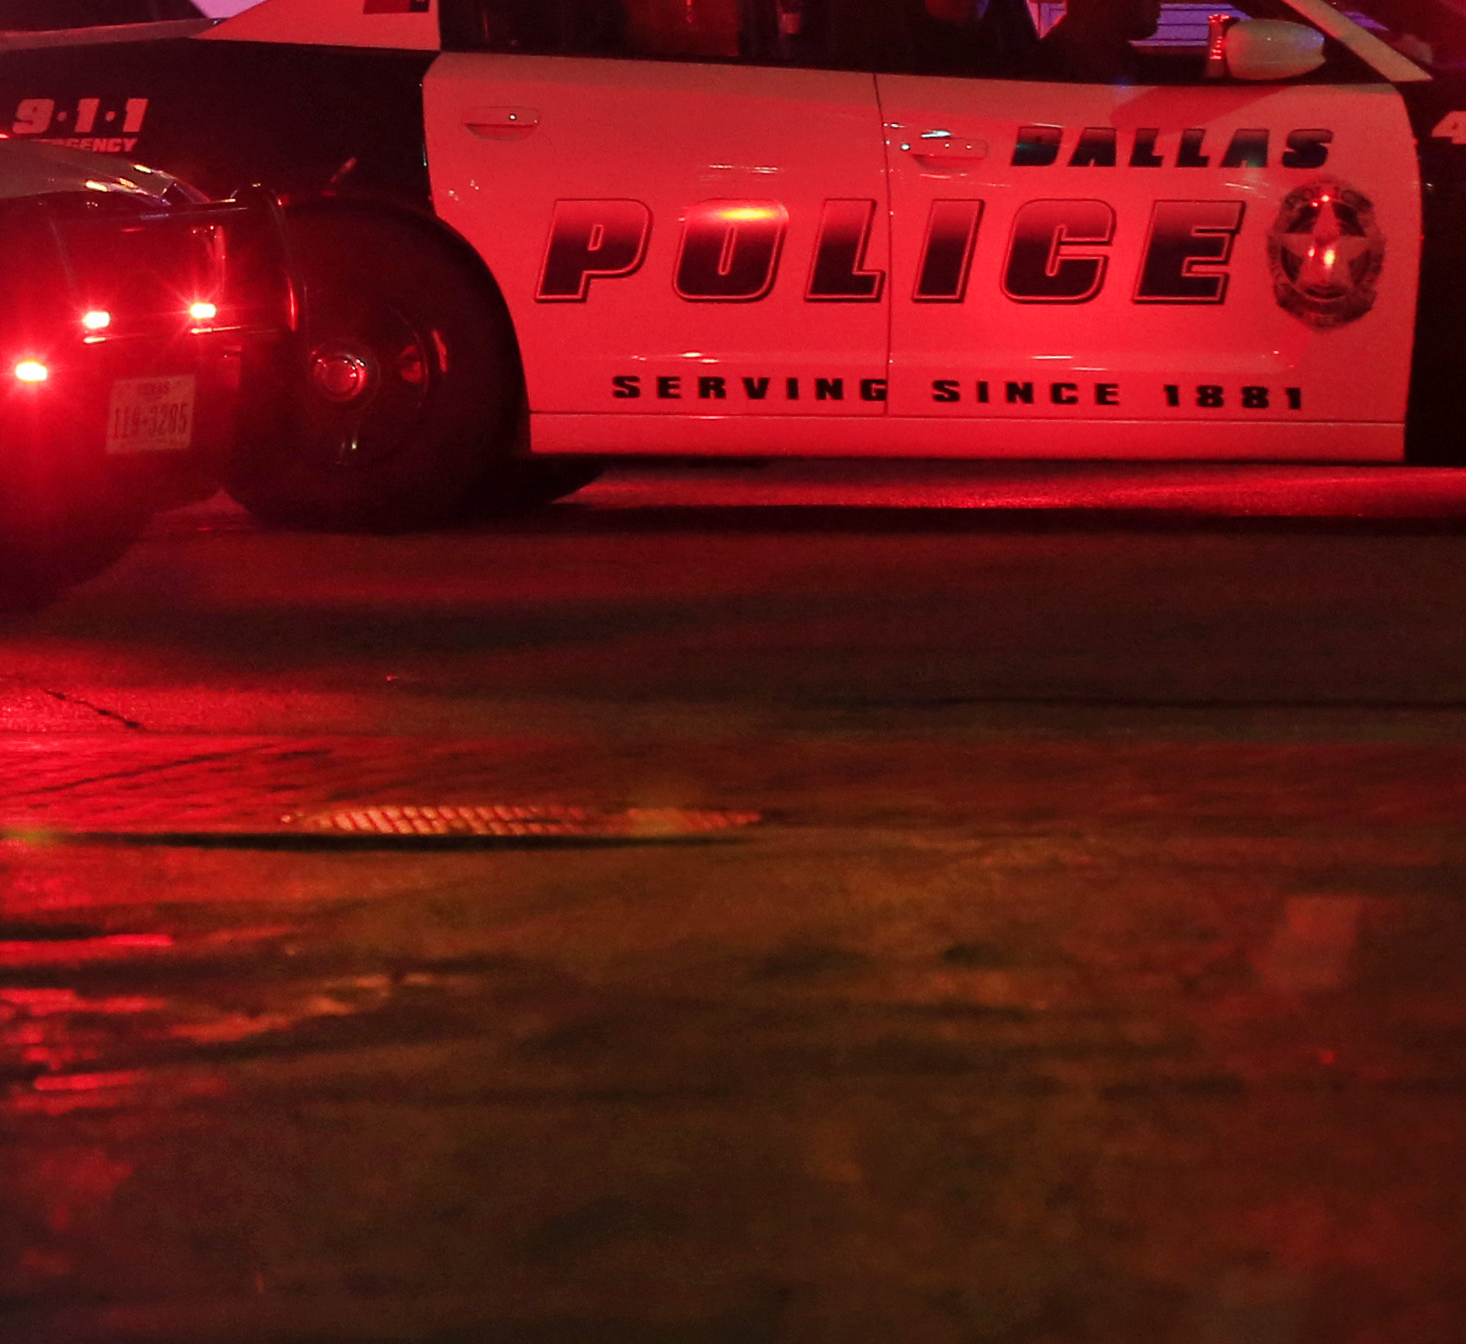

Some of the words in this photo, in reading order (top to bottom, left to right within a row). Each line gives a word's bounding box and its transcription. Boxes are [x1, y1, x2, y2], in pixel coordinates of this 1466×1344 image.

[1010, 126, 1333, 169] DALLAS
[534, 198, 1245, 304] POLICE
[611, 375, 888, 401] SERVING
[932, 380, 1120, 406] SINCE
[1163, 384, 1303, 410] 1881
